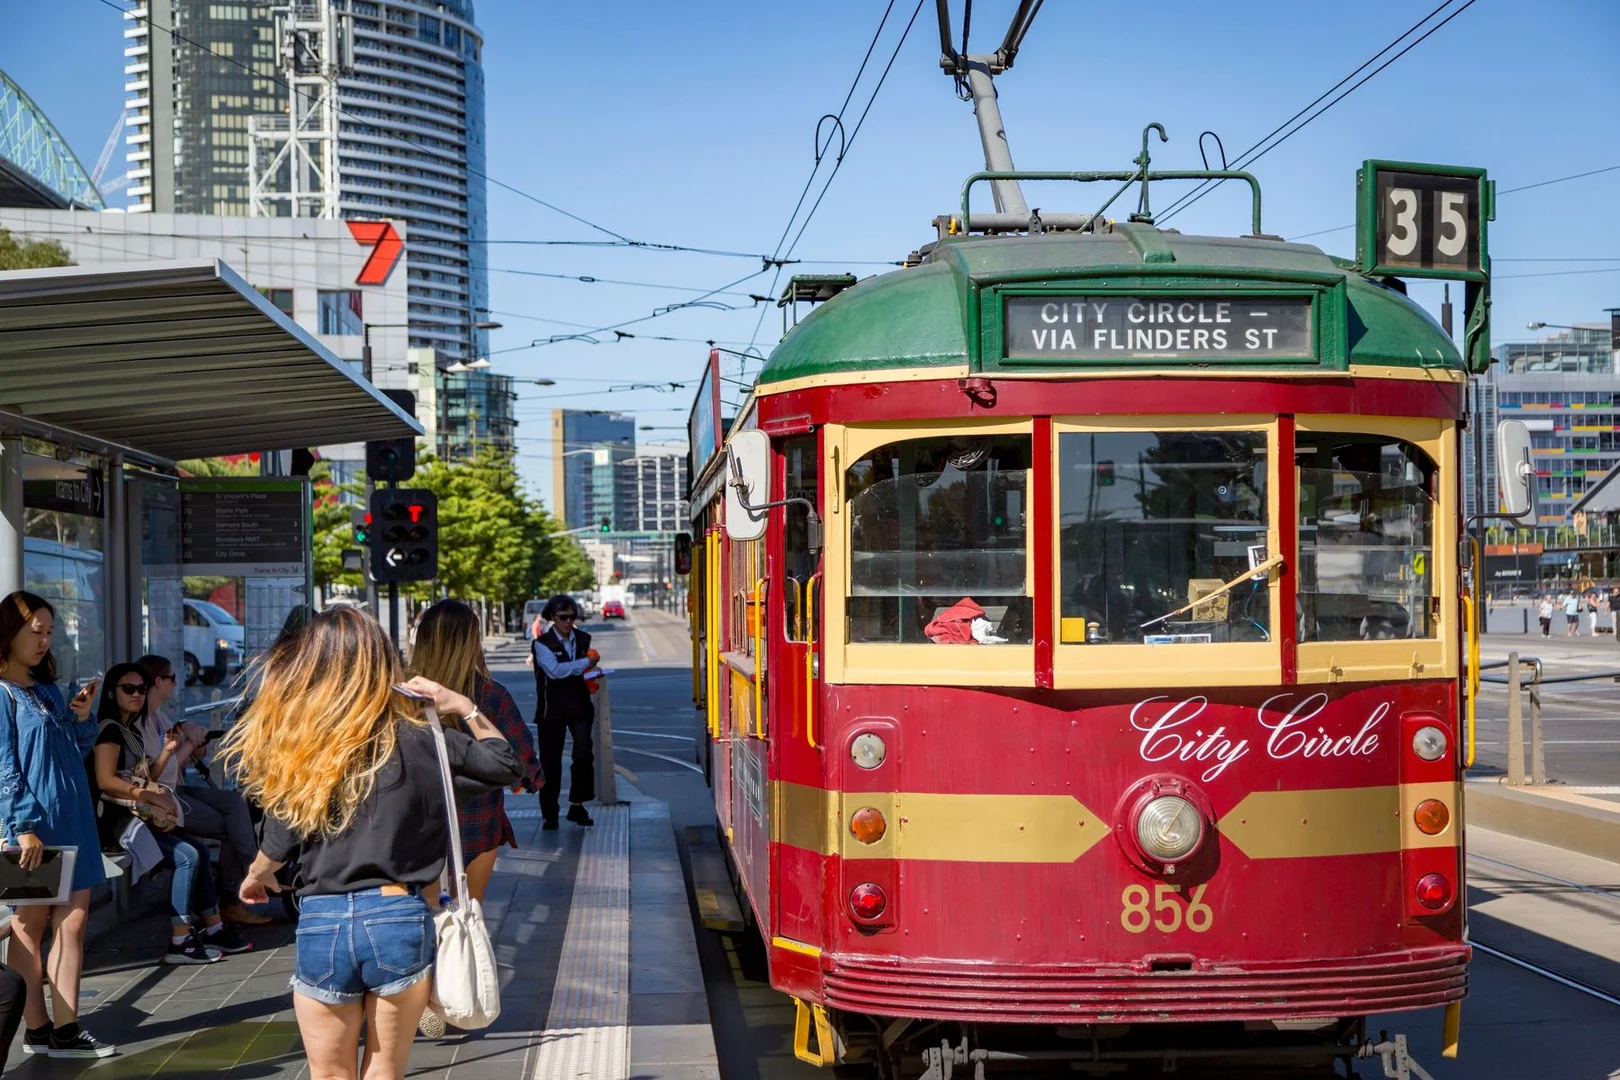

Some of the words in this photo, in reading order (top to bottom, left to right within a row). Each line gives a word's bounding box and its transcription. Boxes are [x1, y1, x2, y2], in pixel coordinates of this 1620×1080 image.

[1387, 188, 1467, 257] 35
[345, 220, 406, 286] 7
[1031, 328, 1077, 350] VIA
[1093, 328, 1228, 350] FLINDERS
[1245, 328, 1278, 350] ST
[1040, 302, 1108, 324] CITY
[1127, 302, 1232, 324] CIRCLE
[1129, 695, 1250, 783] City
[1257, 692, 1390, 760] Circle
[1120, 883, 1214, 934] 856
